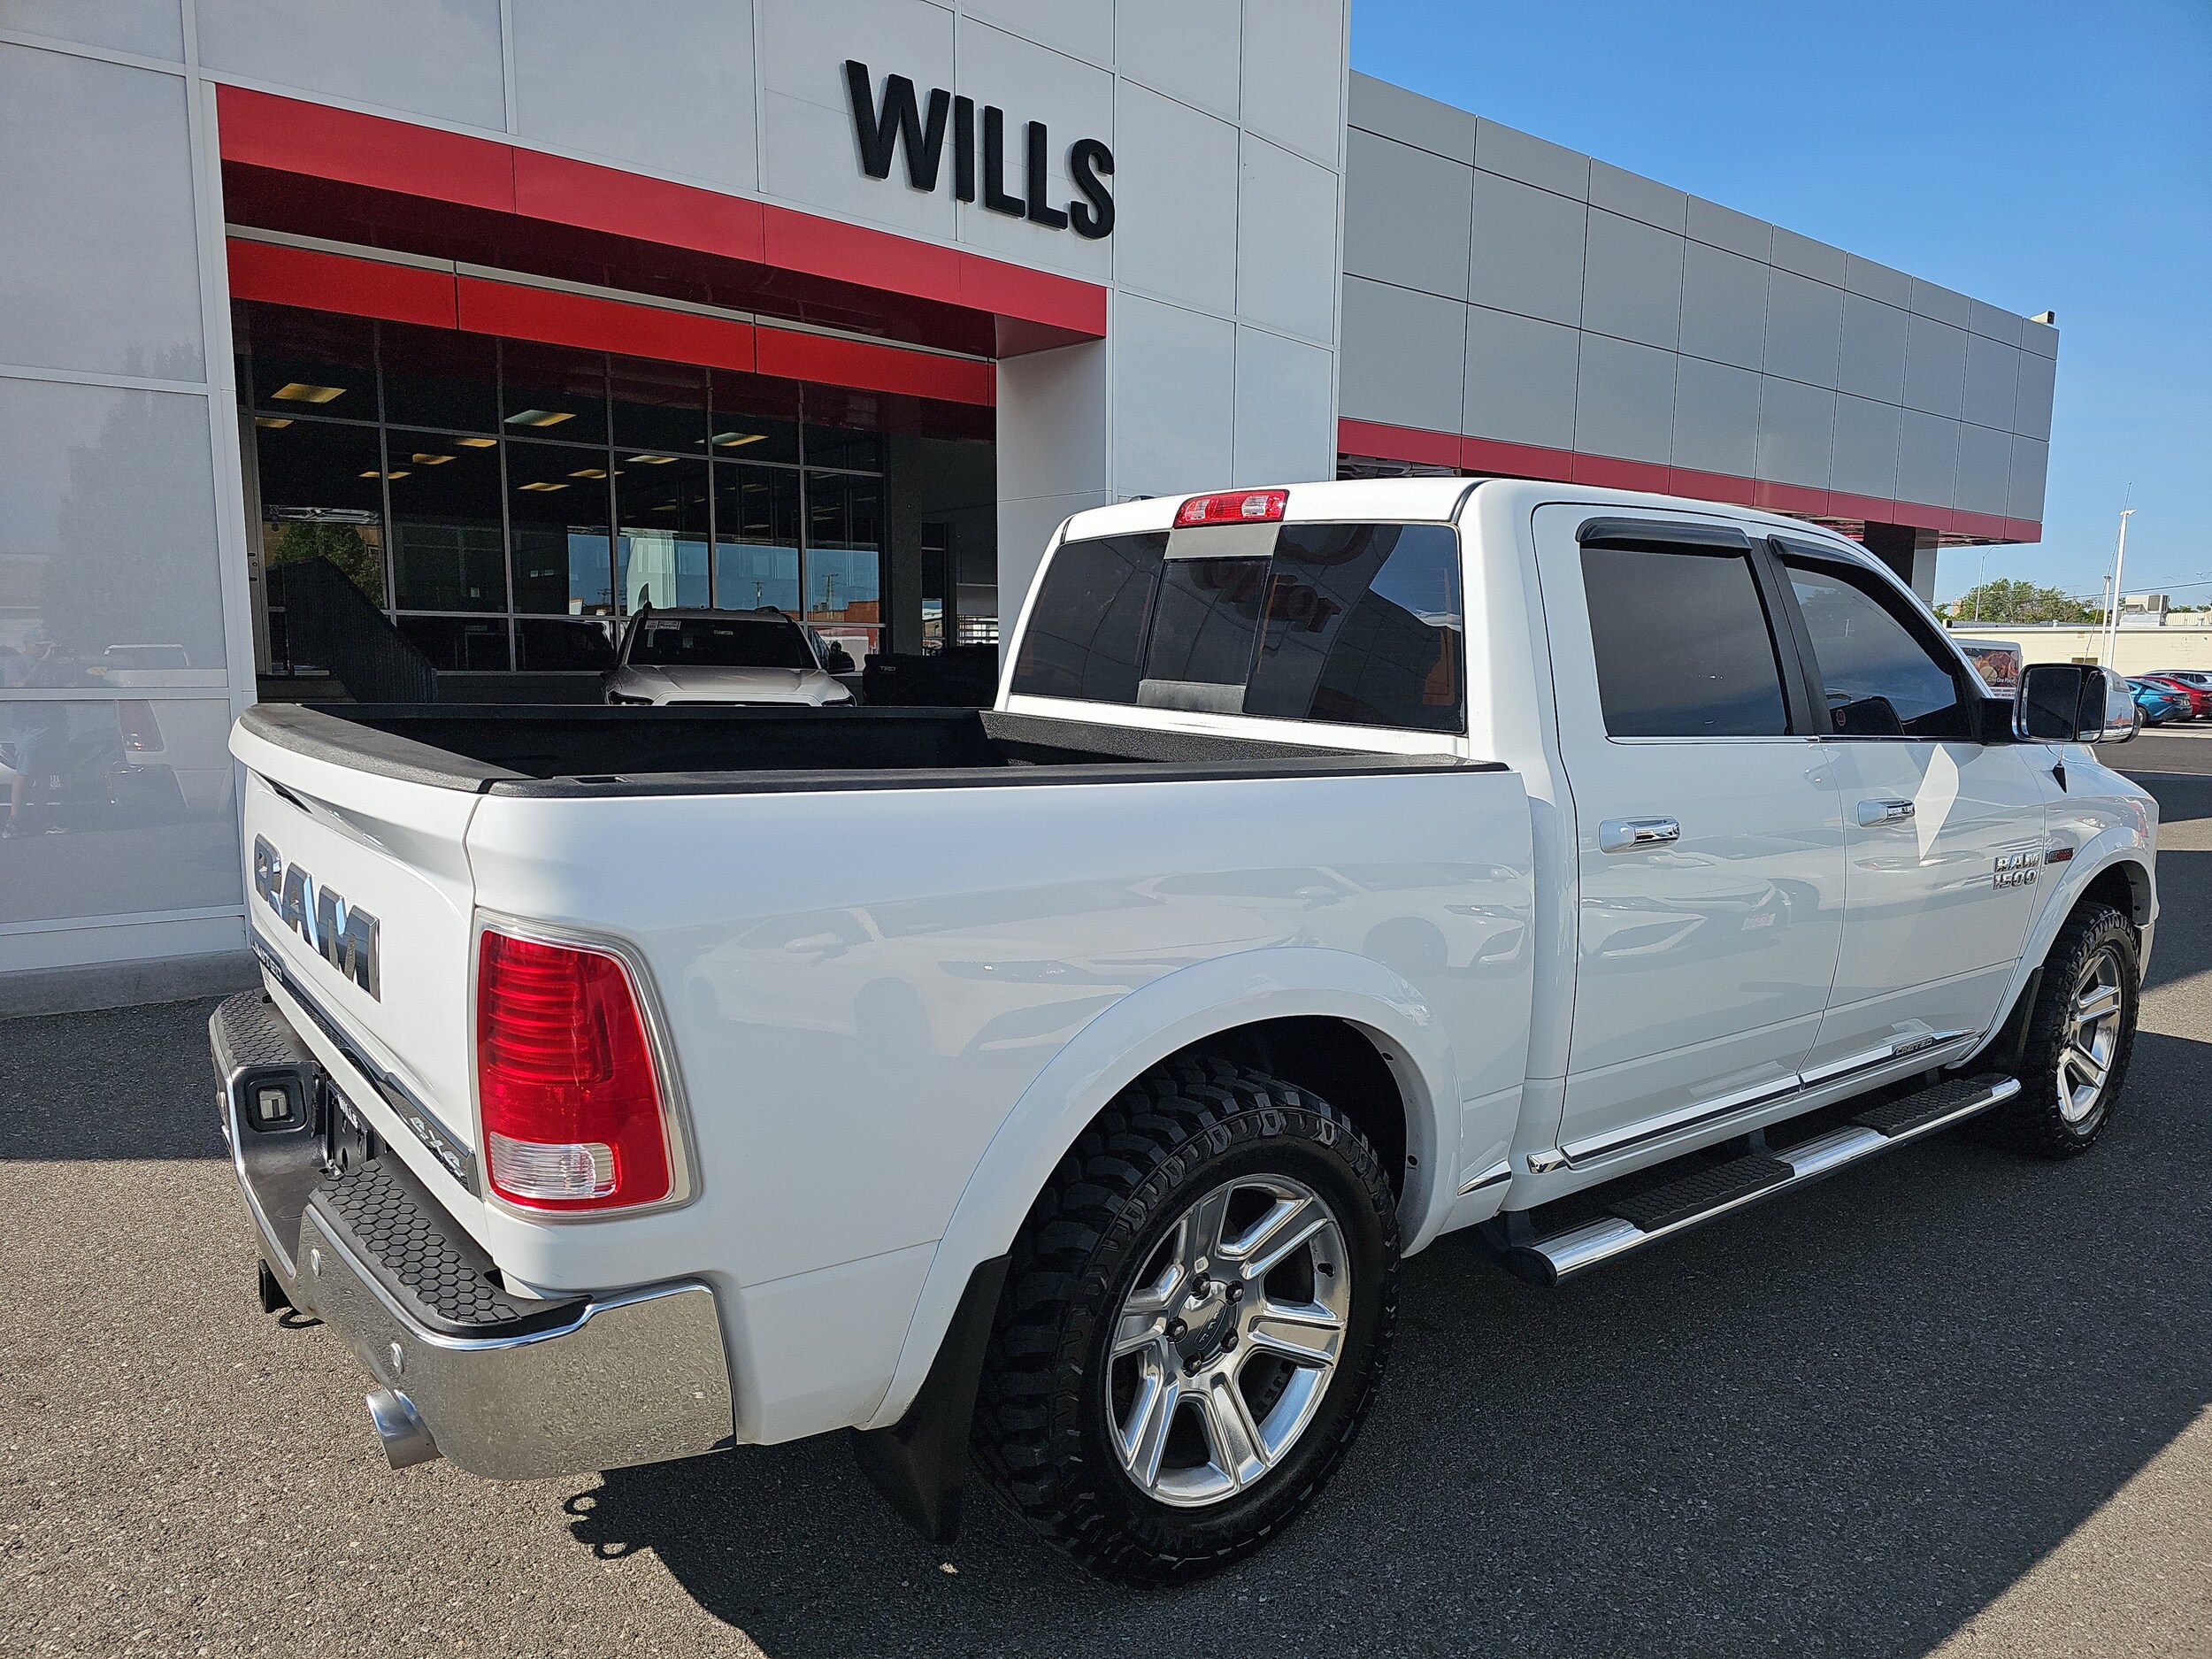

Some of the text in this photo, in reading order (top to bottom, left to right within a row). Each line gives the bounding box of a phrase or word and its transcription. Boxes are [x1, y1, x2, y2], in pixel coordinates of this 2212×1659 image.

[845, 59, 1115, 240] WILLS
[1993, 854, 2040, 872] RAM
[1993, 868, 2038, 890] 1500
[254, 833, 380, 1003] RAM
